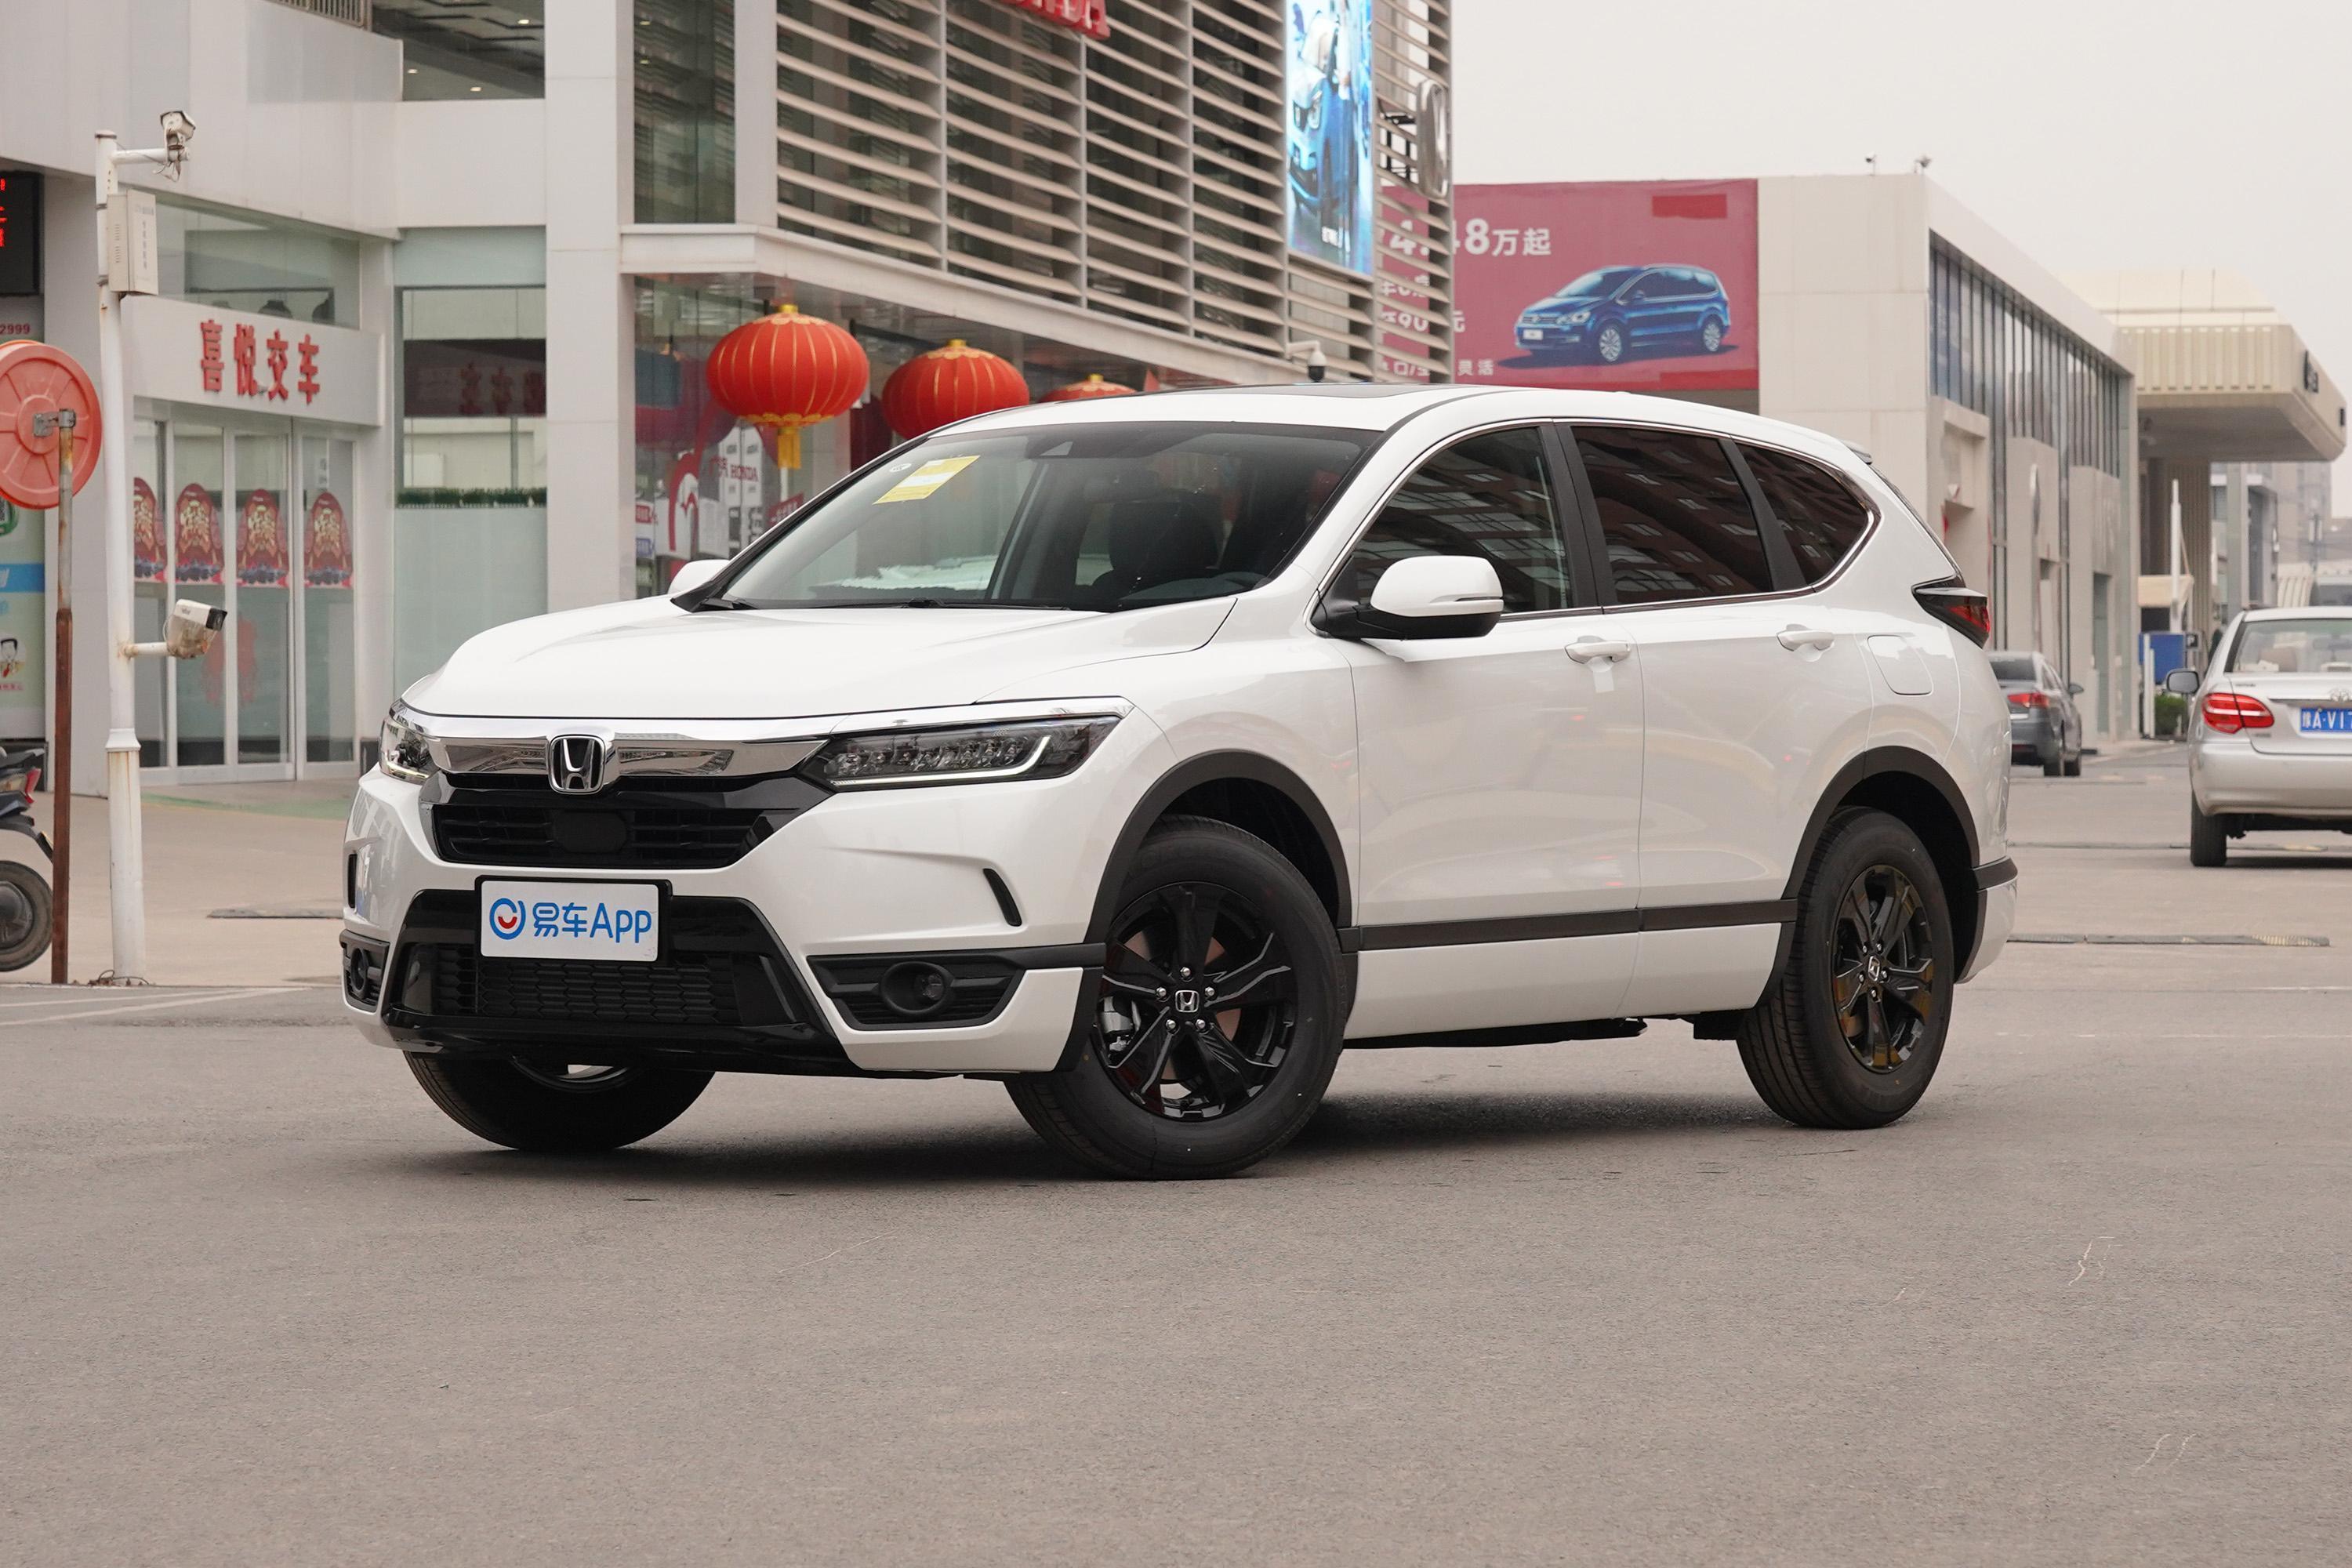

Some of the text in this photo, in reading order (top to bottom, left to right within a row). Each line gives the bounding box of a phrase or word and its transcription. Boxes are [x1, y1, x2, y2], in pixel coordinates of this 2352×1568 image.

[201, 319, 320, 405] 喜悦交车
[532, 902, 652, 943] 易车App
